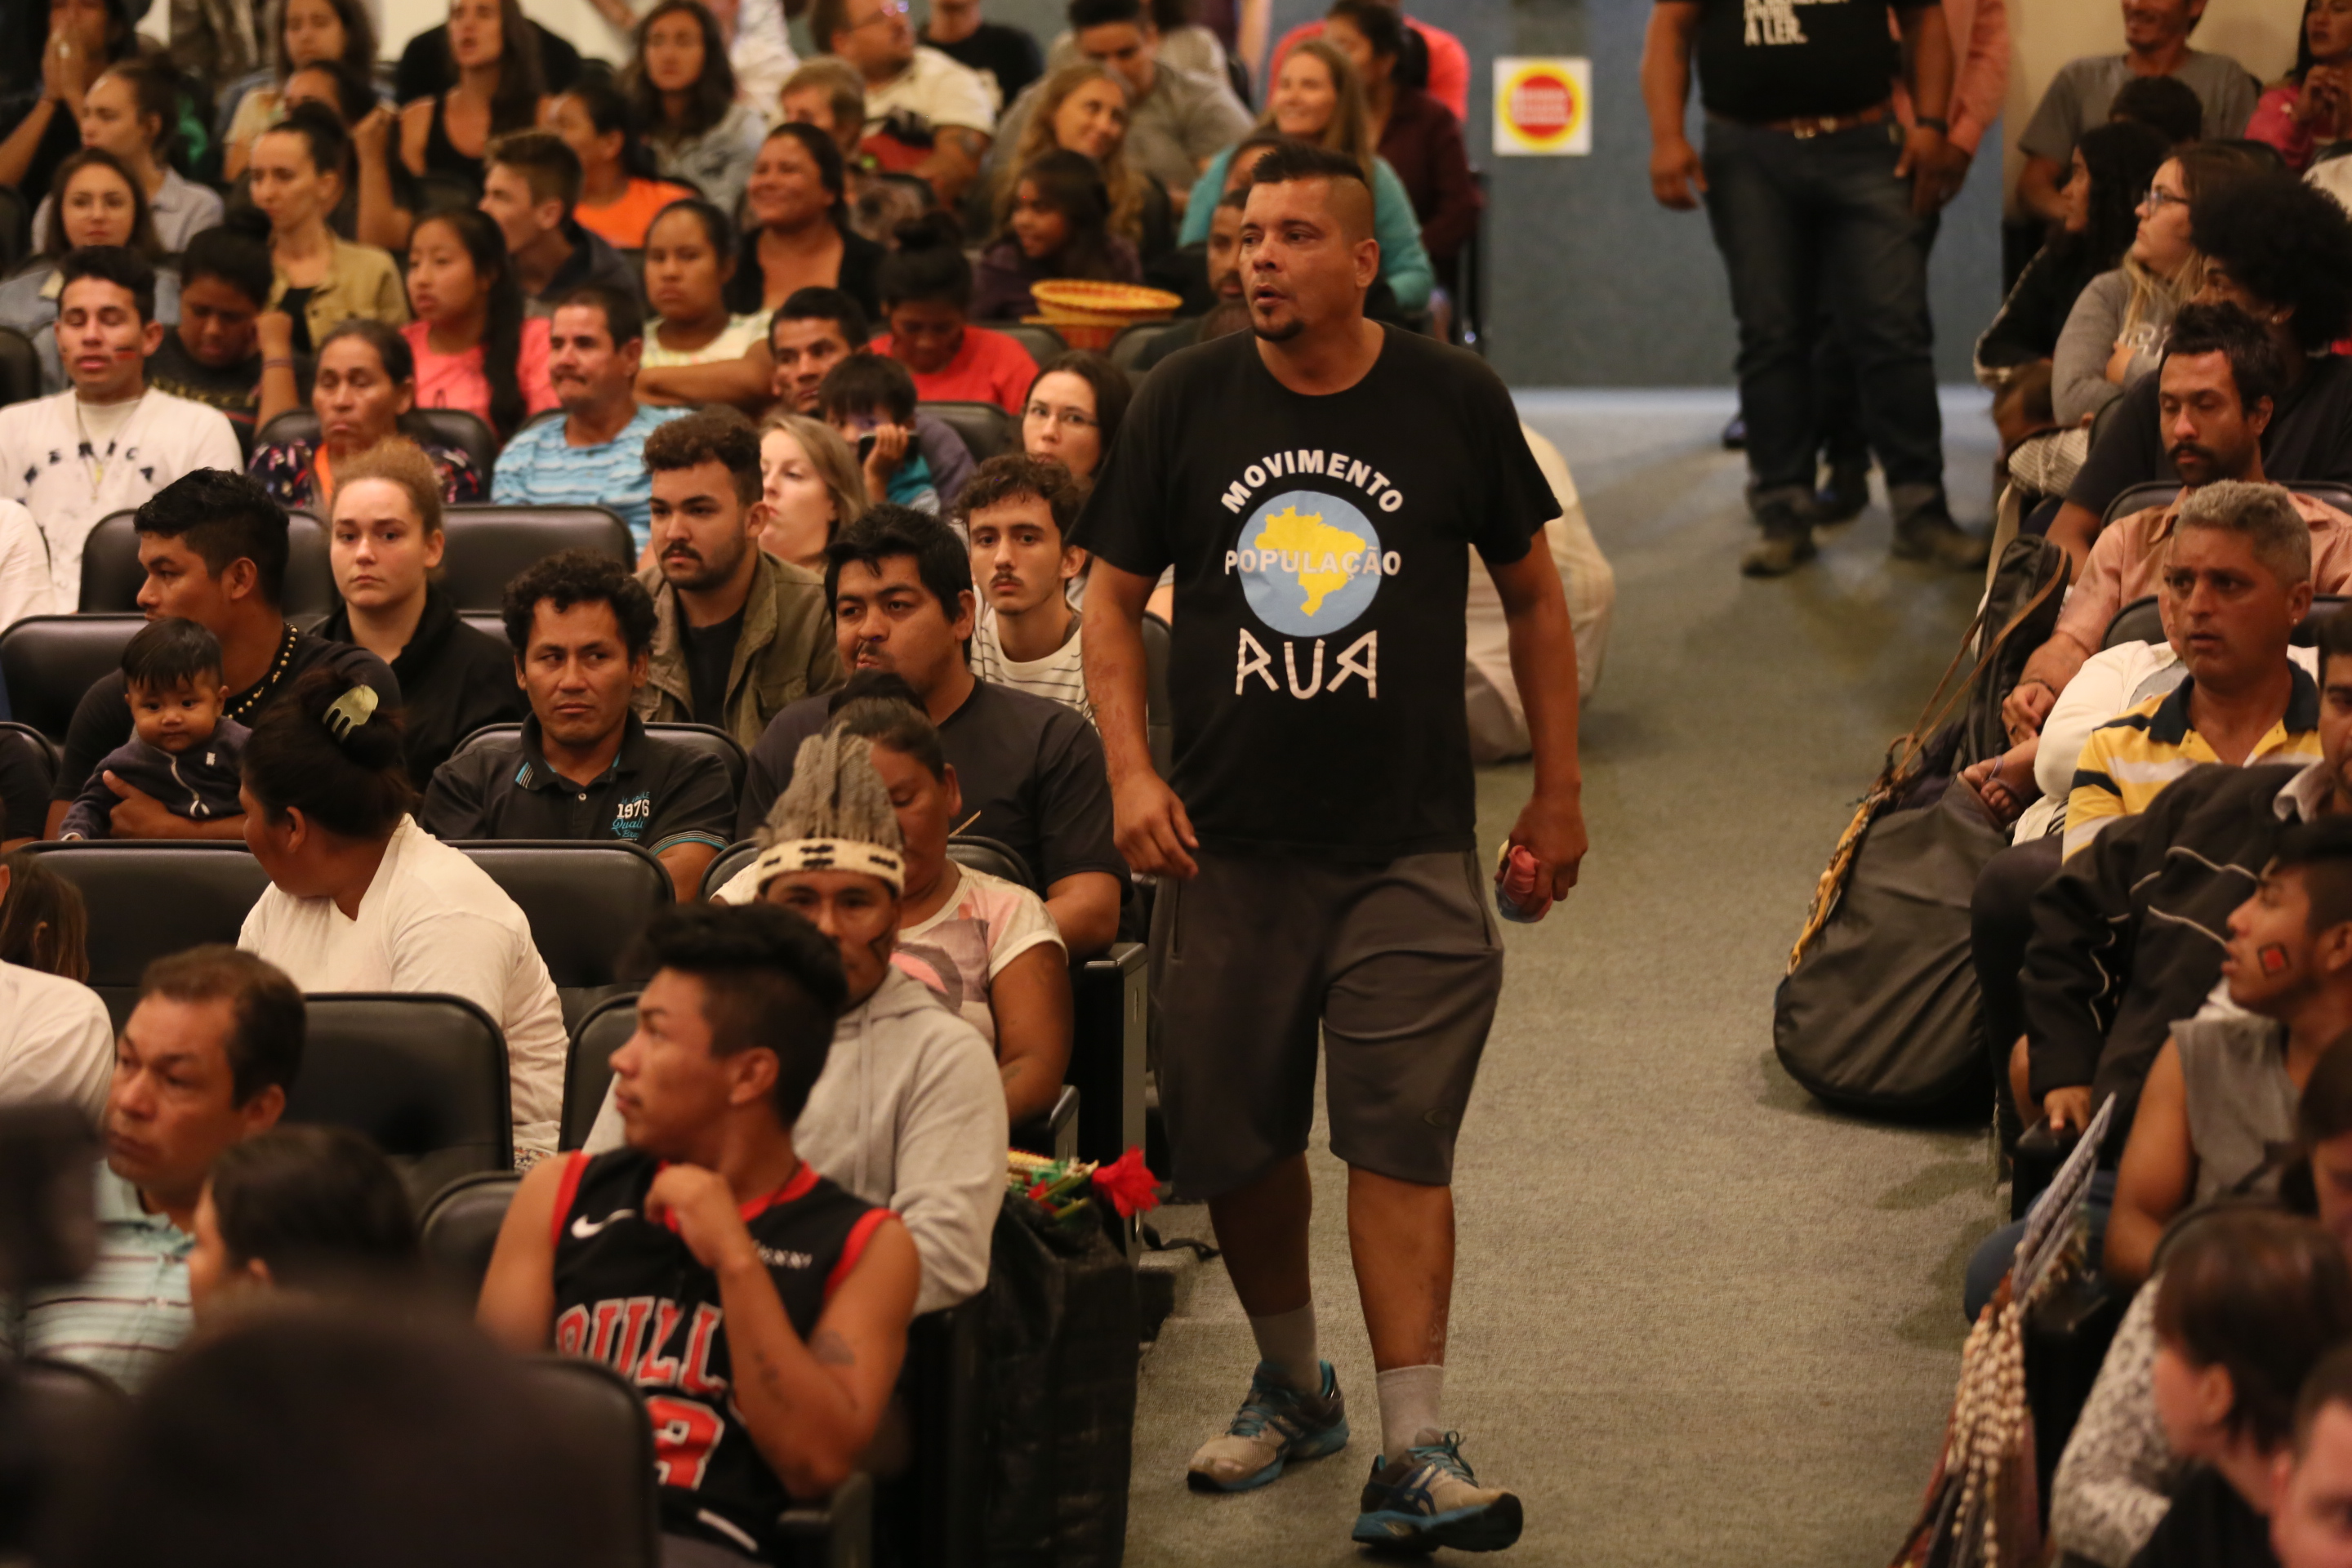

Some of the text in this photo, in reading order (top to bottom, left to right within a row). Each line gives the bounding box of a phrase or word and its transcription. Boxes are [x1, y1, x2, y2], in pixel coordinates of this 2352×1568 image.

[1221, 449, 1404, 514] MOVIMENTO
[1224, 546, 1402, 581] POPULAÇÃO
[1235, 627, 1379, 700] RUA
[611, 817, 644, 835] Quali
[617, 799, 650, 819] 1976
